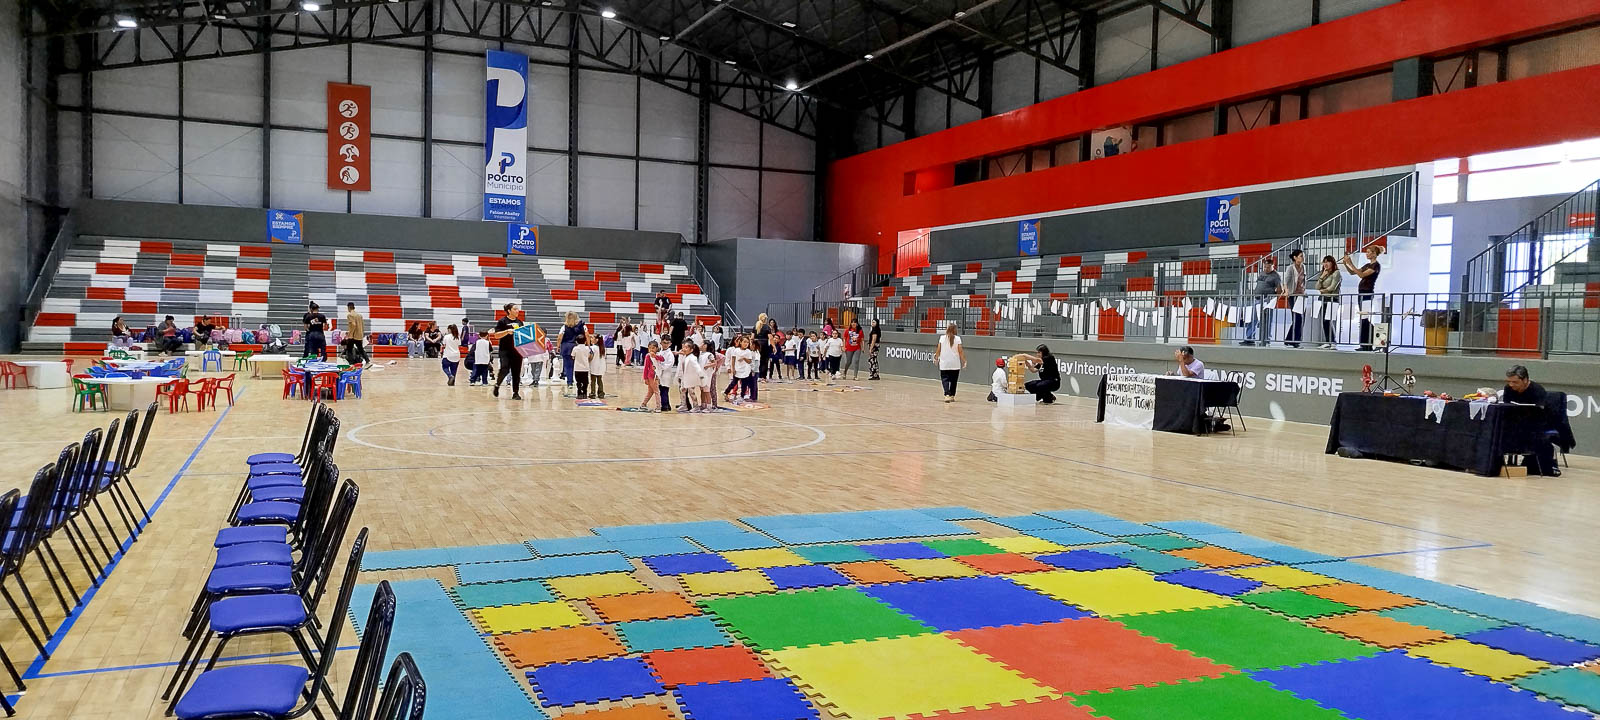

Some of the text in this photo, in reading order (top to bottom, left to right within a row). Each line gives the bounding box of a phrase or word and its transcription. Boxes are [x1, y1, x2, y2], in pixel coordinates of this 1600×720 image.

[487, 174, 524, 183] POCITO
[487, 182, 524, 190] Municipio
[886, 347, 911, 359] POCITO
[1075, 361, 1135, 375] Intendente
[1265, 374, 1344, 396] SIEMPRE
